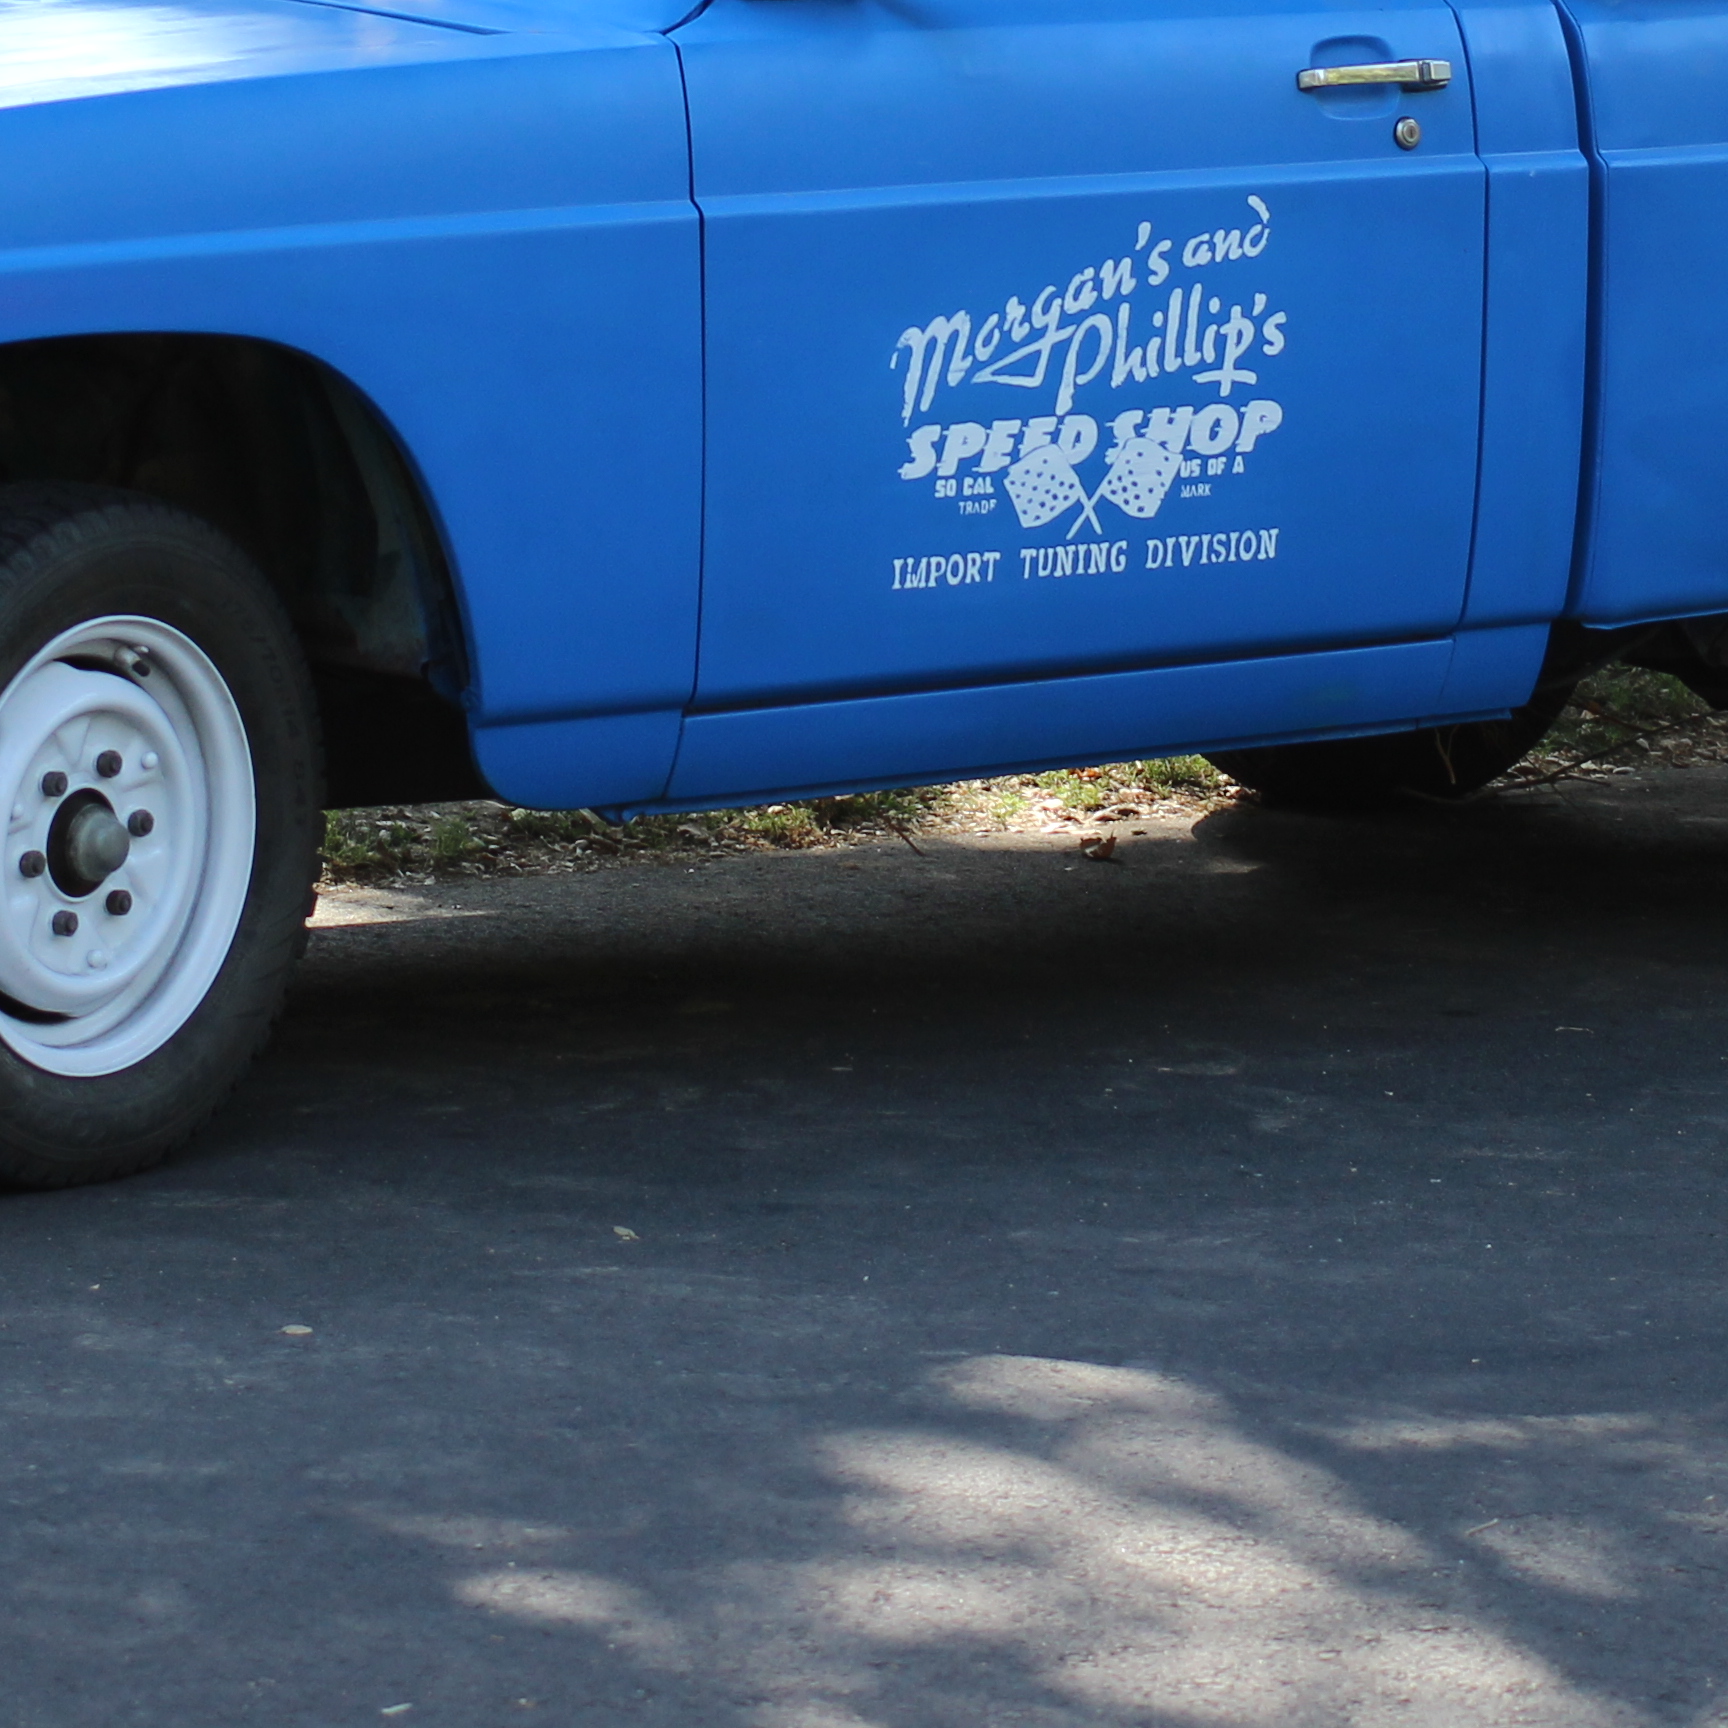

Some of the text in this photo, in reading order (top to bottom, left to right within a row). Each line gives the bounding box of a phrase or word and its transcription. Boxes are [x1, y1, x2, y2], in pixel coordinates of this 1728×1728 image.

[889, 193, 1271, 427] Morgan's and
[1055, 282, 1288, 416] Phillip's
[898, 399, 1284, 480] SPEED SHOP
[1178, 455, 1246, 479] US OF A
[934, 475, 995, 499] SO CAL
[1180, 482, 1212, 499] MARK
[891, 527, 1280, 590] IMPORT TUNING DIVISION
